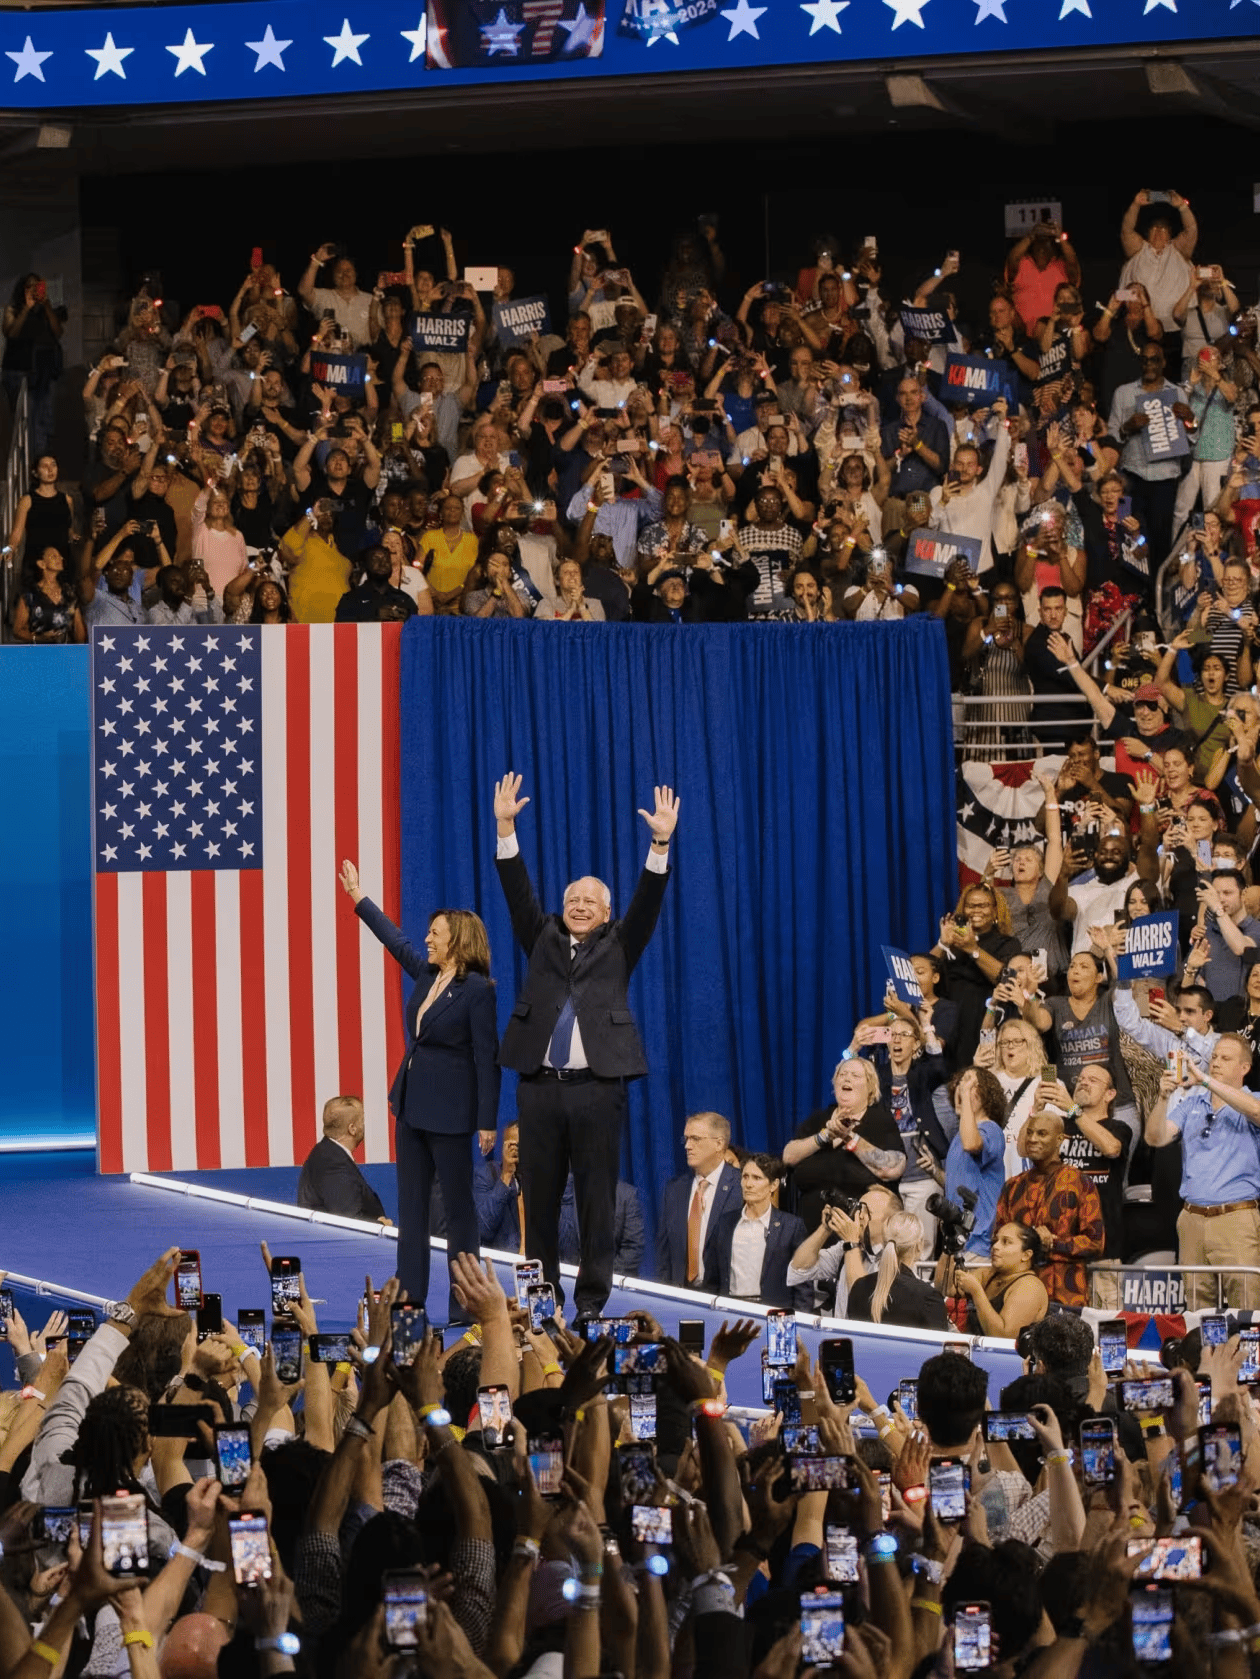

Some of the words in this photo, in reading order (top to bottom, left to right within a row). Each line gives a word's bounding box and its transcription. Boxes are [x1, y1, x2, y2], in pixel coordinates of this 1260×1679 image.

[678, 0, 717, 23] 2024
[499, 301, 547, 328] HARRIS
[900, 310, 947, 329] HARRIS
[416, 316, 466, 336] HARRIS
[511, 320, 543, 337] WALZ
[424, 335, 458, 347] WALZ
[1038, 342, 1067, 367] ARRIS
[947, 363, 1000, 392] KAMALA
[1143, 398, 1171, 454] HARRIS
[1163, 405, 1180, 441] WALZ
[1124, 921, 1172, 954] HARRIS
[1132, 950, 1164, 969] WALZ
[1061, 1037, 1102, 1053] HARRIS
[1063, 1057, 1082, 1066] 2024
[1060, 1138, 1102, 1158] ARRIS
[1124, 1279, 1188, 1306] HARRI
